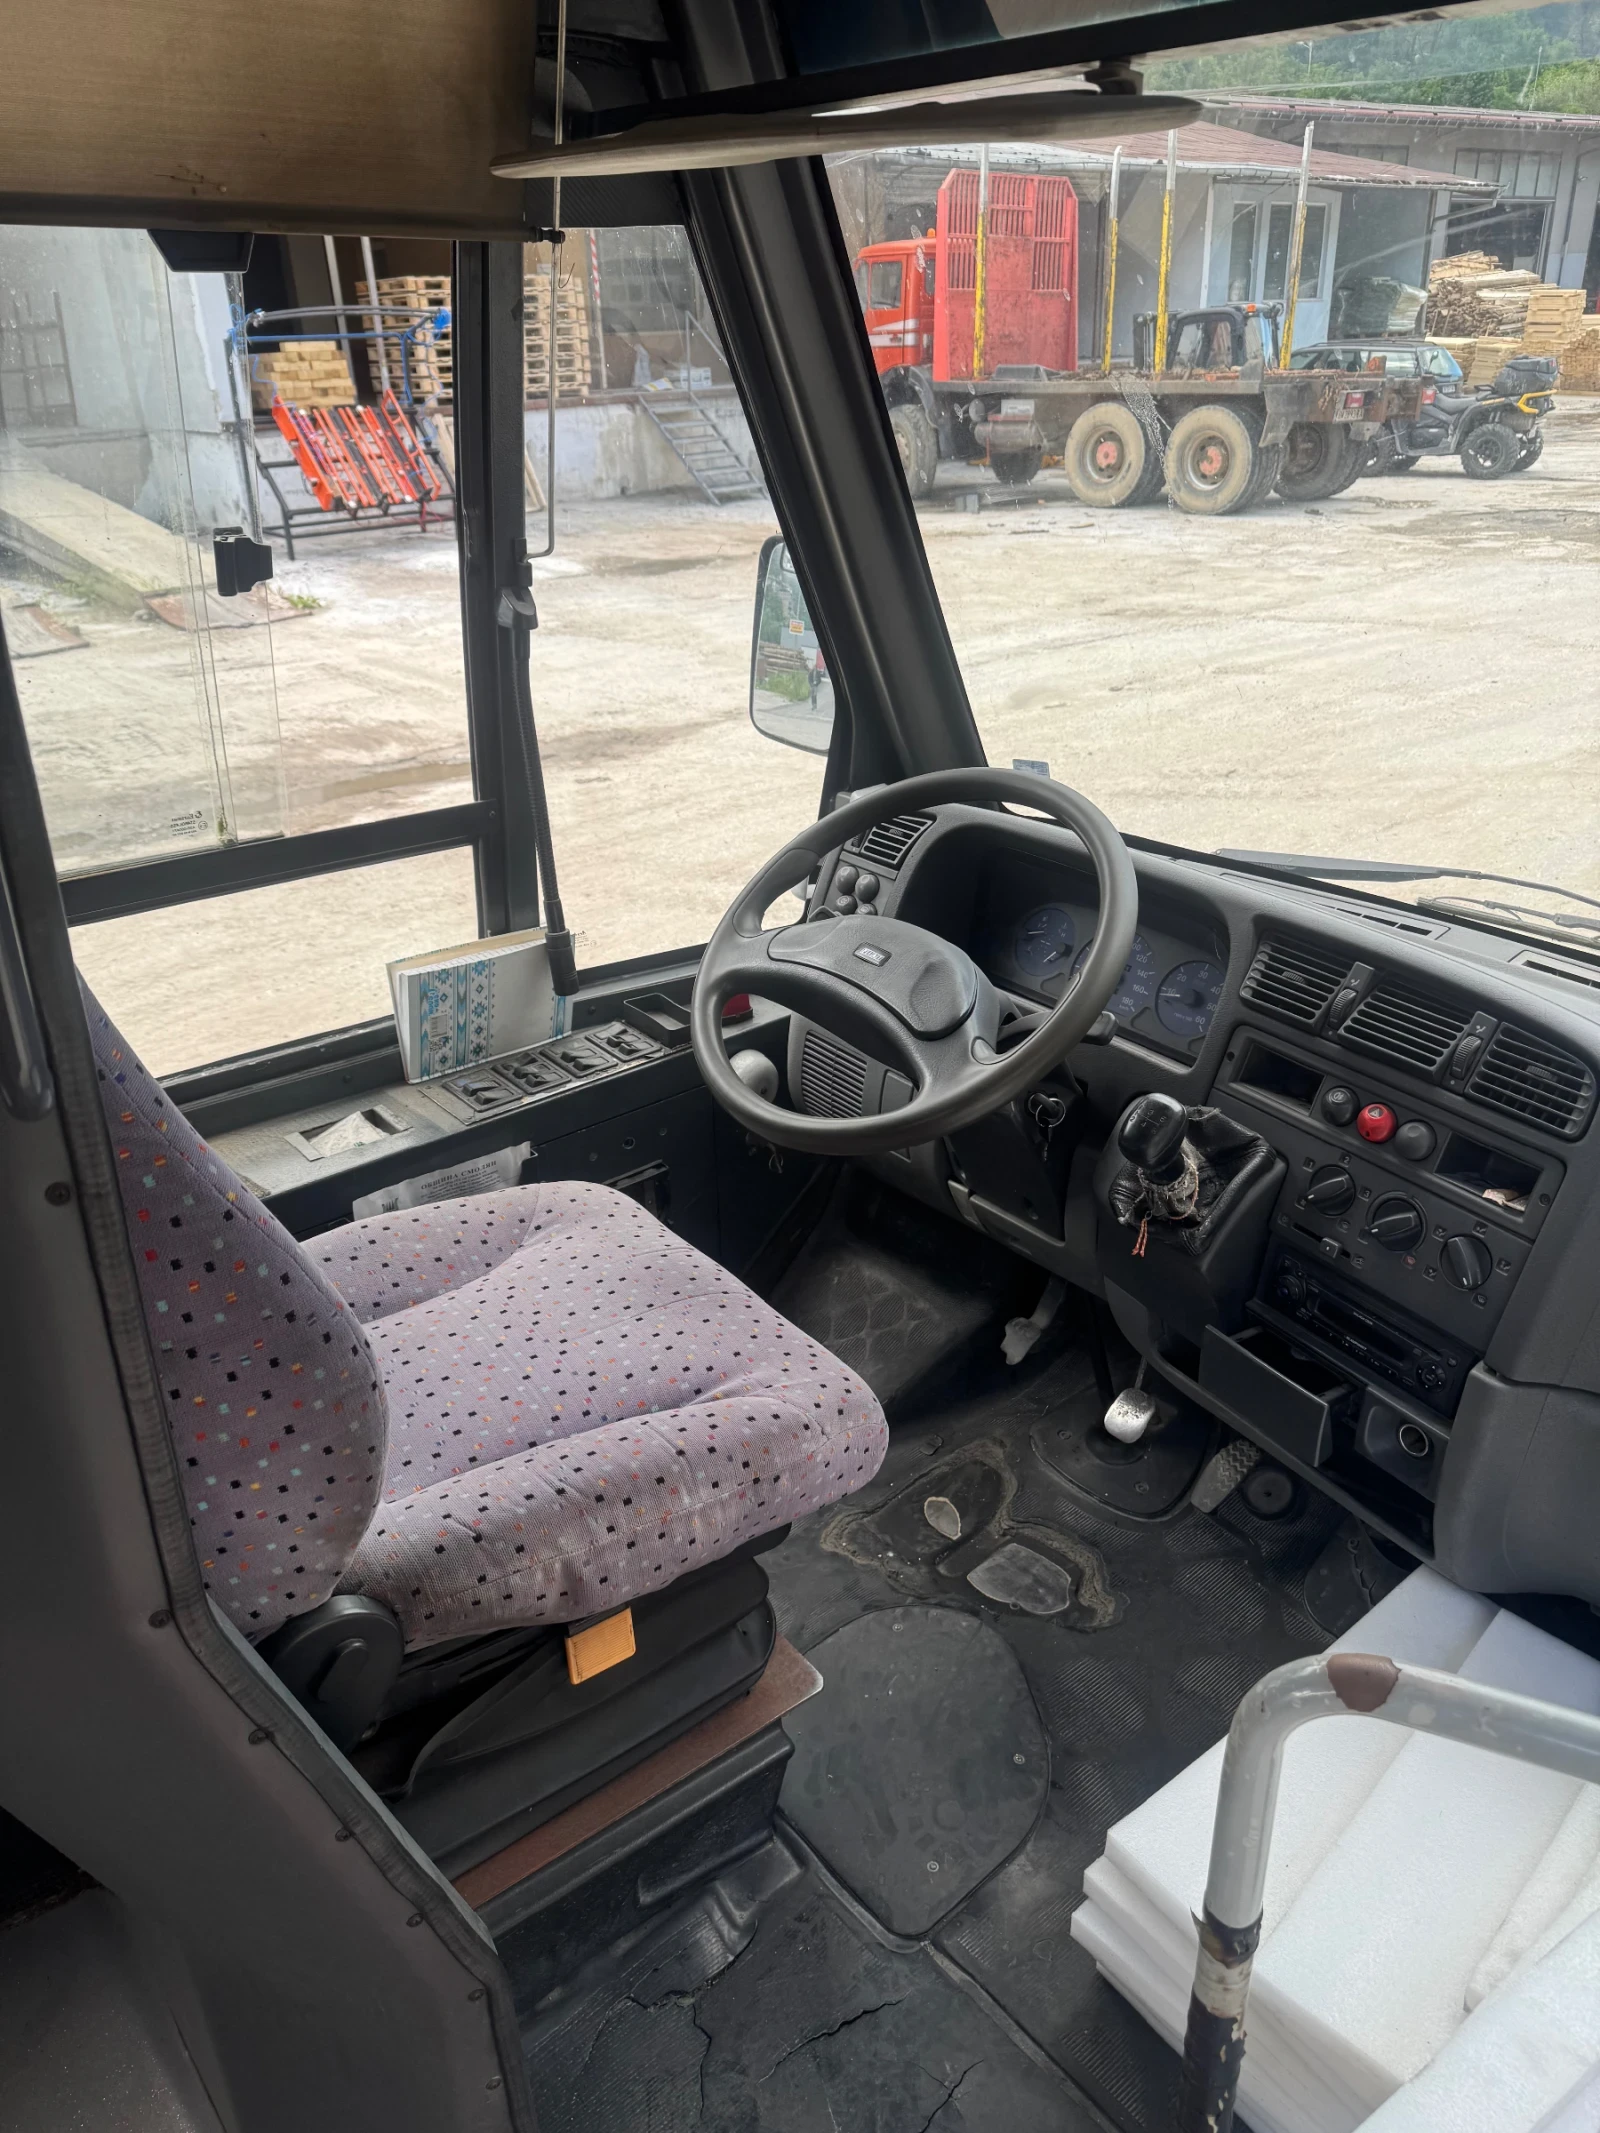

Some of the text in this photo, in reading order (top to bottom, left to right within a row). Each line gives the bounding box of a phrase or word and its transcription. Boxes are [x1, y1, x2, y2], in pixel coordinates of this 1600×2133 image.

[1136, 954, 1148, 964] 120
[1136, 969, 1149, 979] 140
[1176, 973, 1187, 982] 20
[1198, 970, 1209, 979] 30
[1132, 984, 1145, 994] 160
[1210, 986, 1221, 995] 40
[1121, 996, 1134, 1006] 180
[1206, 1003, 1217, 1012] 50
[1195, 1015, 1206, 1025] 60
[421, 1173, 458, 1190] ОБЩИНА
